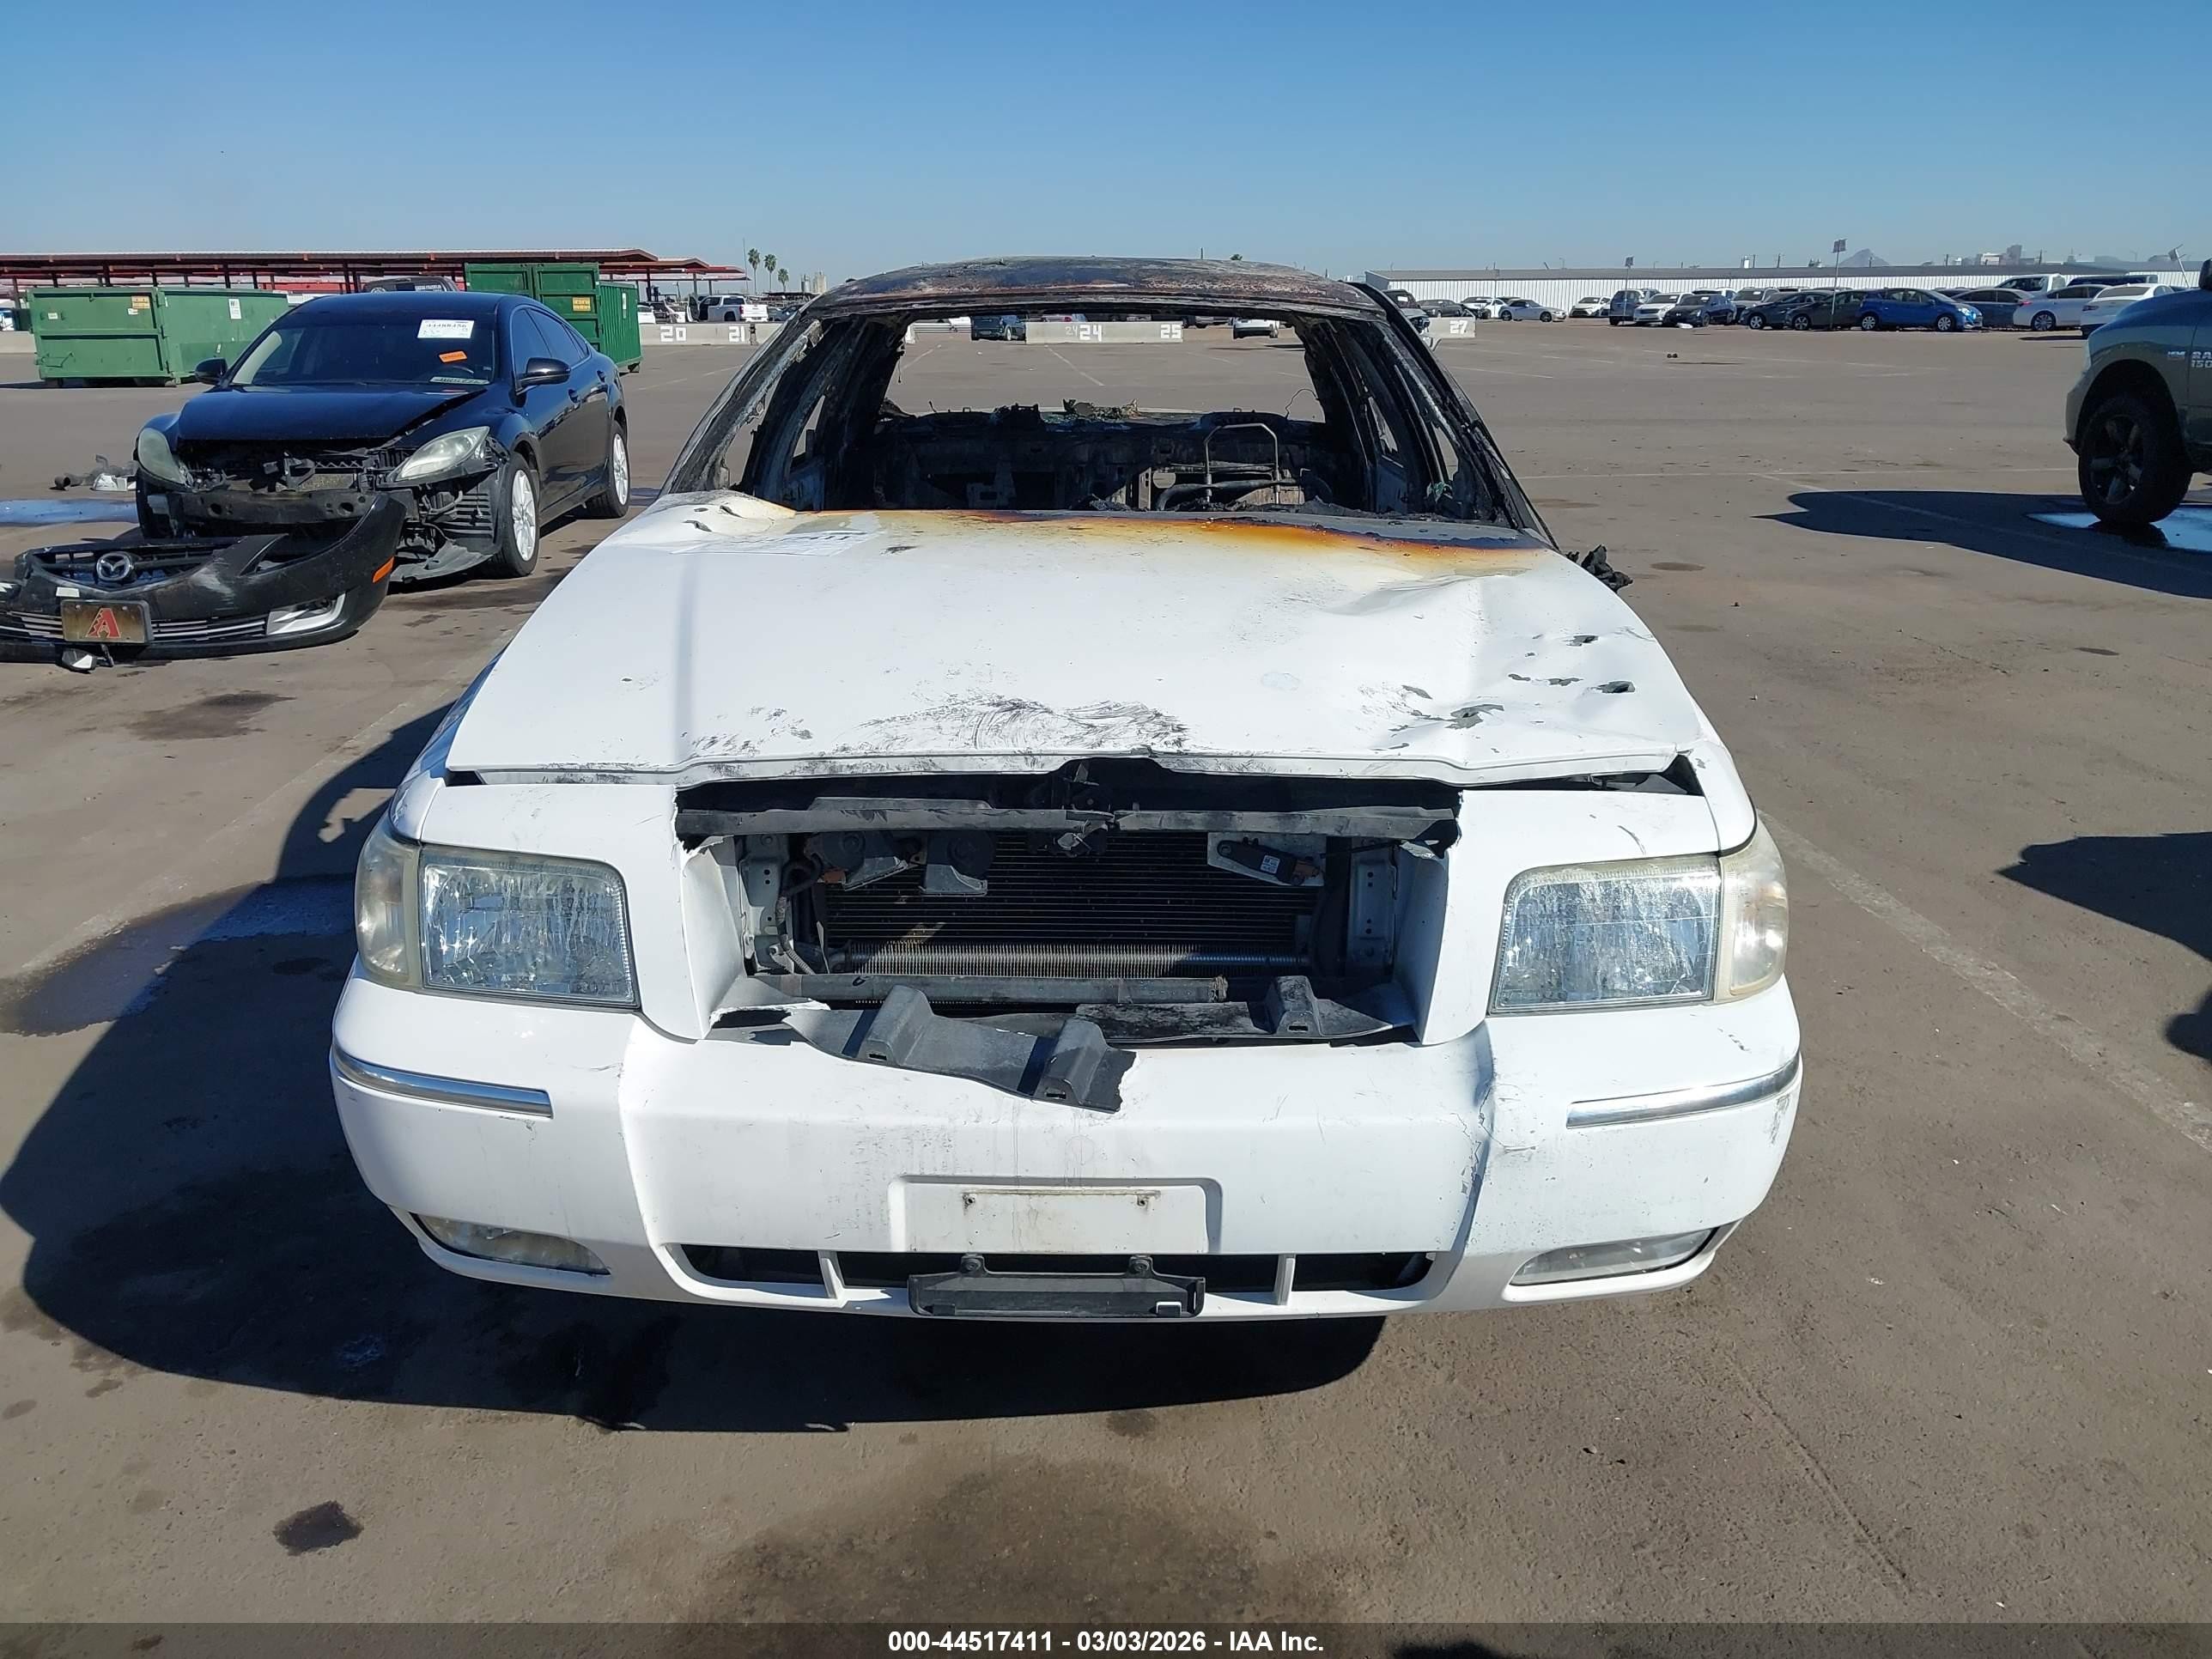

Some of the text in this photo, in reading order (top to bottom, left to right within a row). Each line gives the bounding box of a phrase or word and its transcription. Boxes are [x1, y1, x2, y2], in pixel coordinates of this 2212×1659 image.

[659, 325, 687, 342] 20
[728, 325, 745, 342] 21
[1079, 324, 1103, 342] 24
[1160, 324, 1182, 338] 25
[1449, 320, 1468, 334] 27
[86, 608, 121, 638] A
